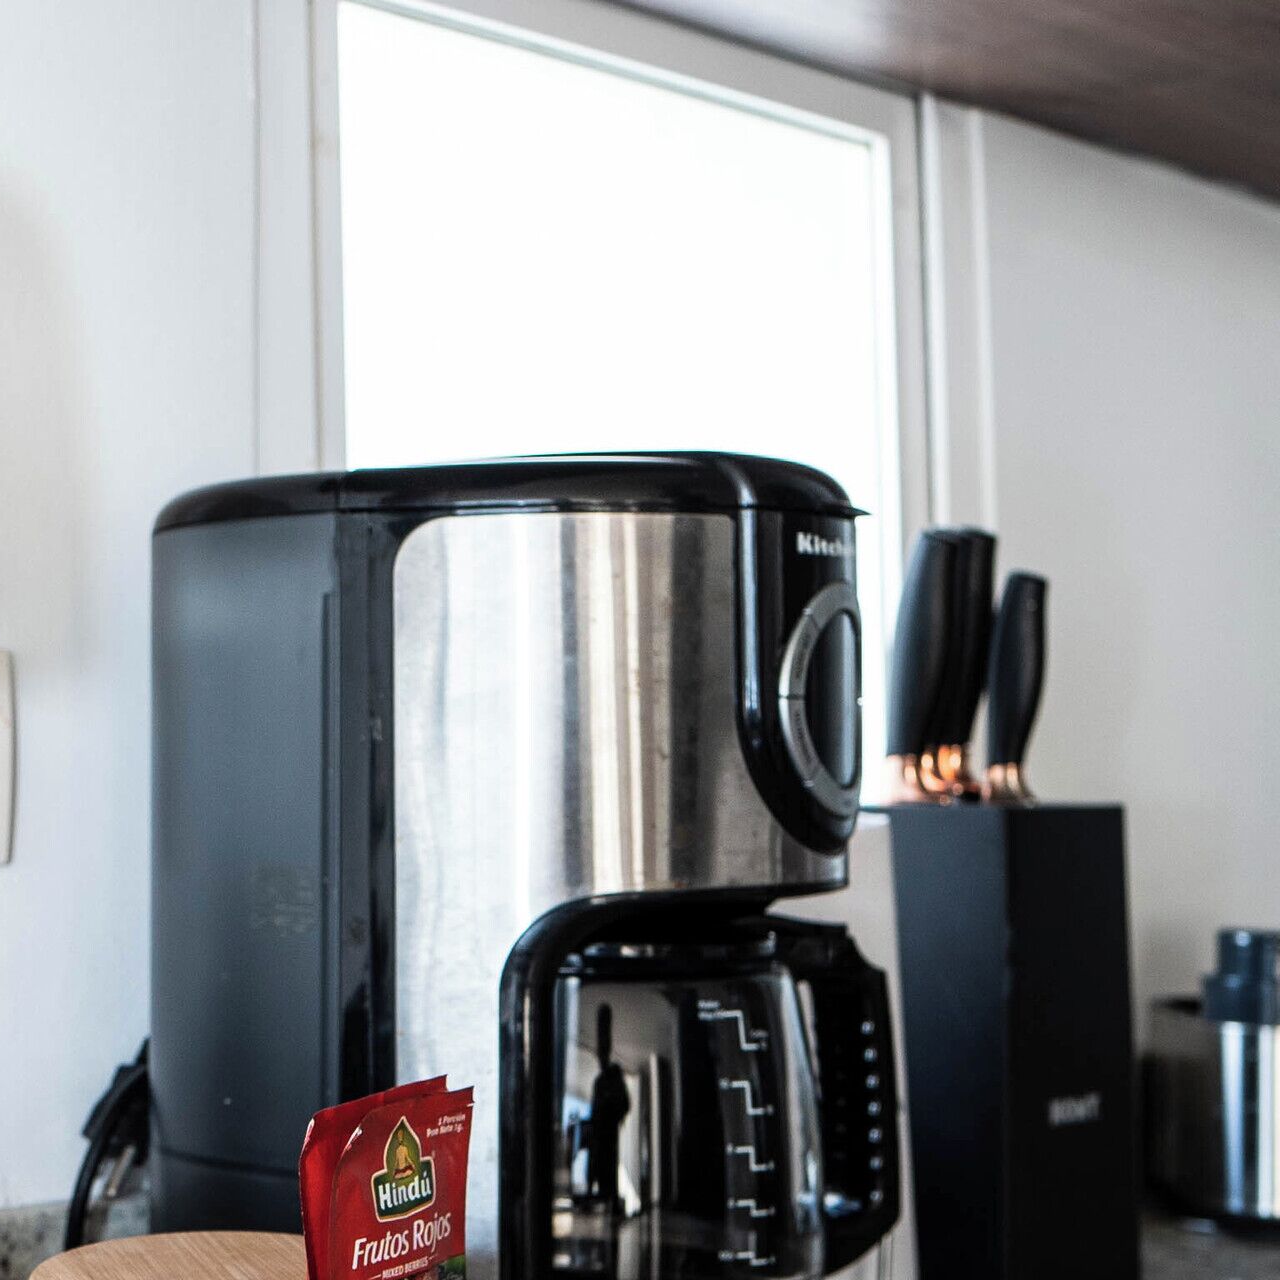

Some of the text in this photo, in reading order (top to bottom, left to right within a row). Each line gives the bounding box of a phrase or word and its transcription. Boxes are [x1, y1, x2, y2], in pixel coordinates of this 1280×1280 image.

[378, 1170, 432, 1210] Hindú
[351, 1212, 452, 1271] Frutos Rojos
